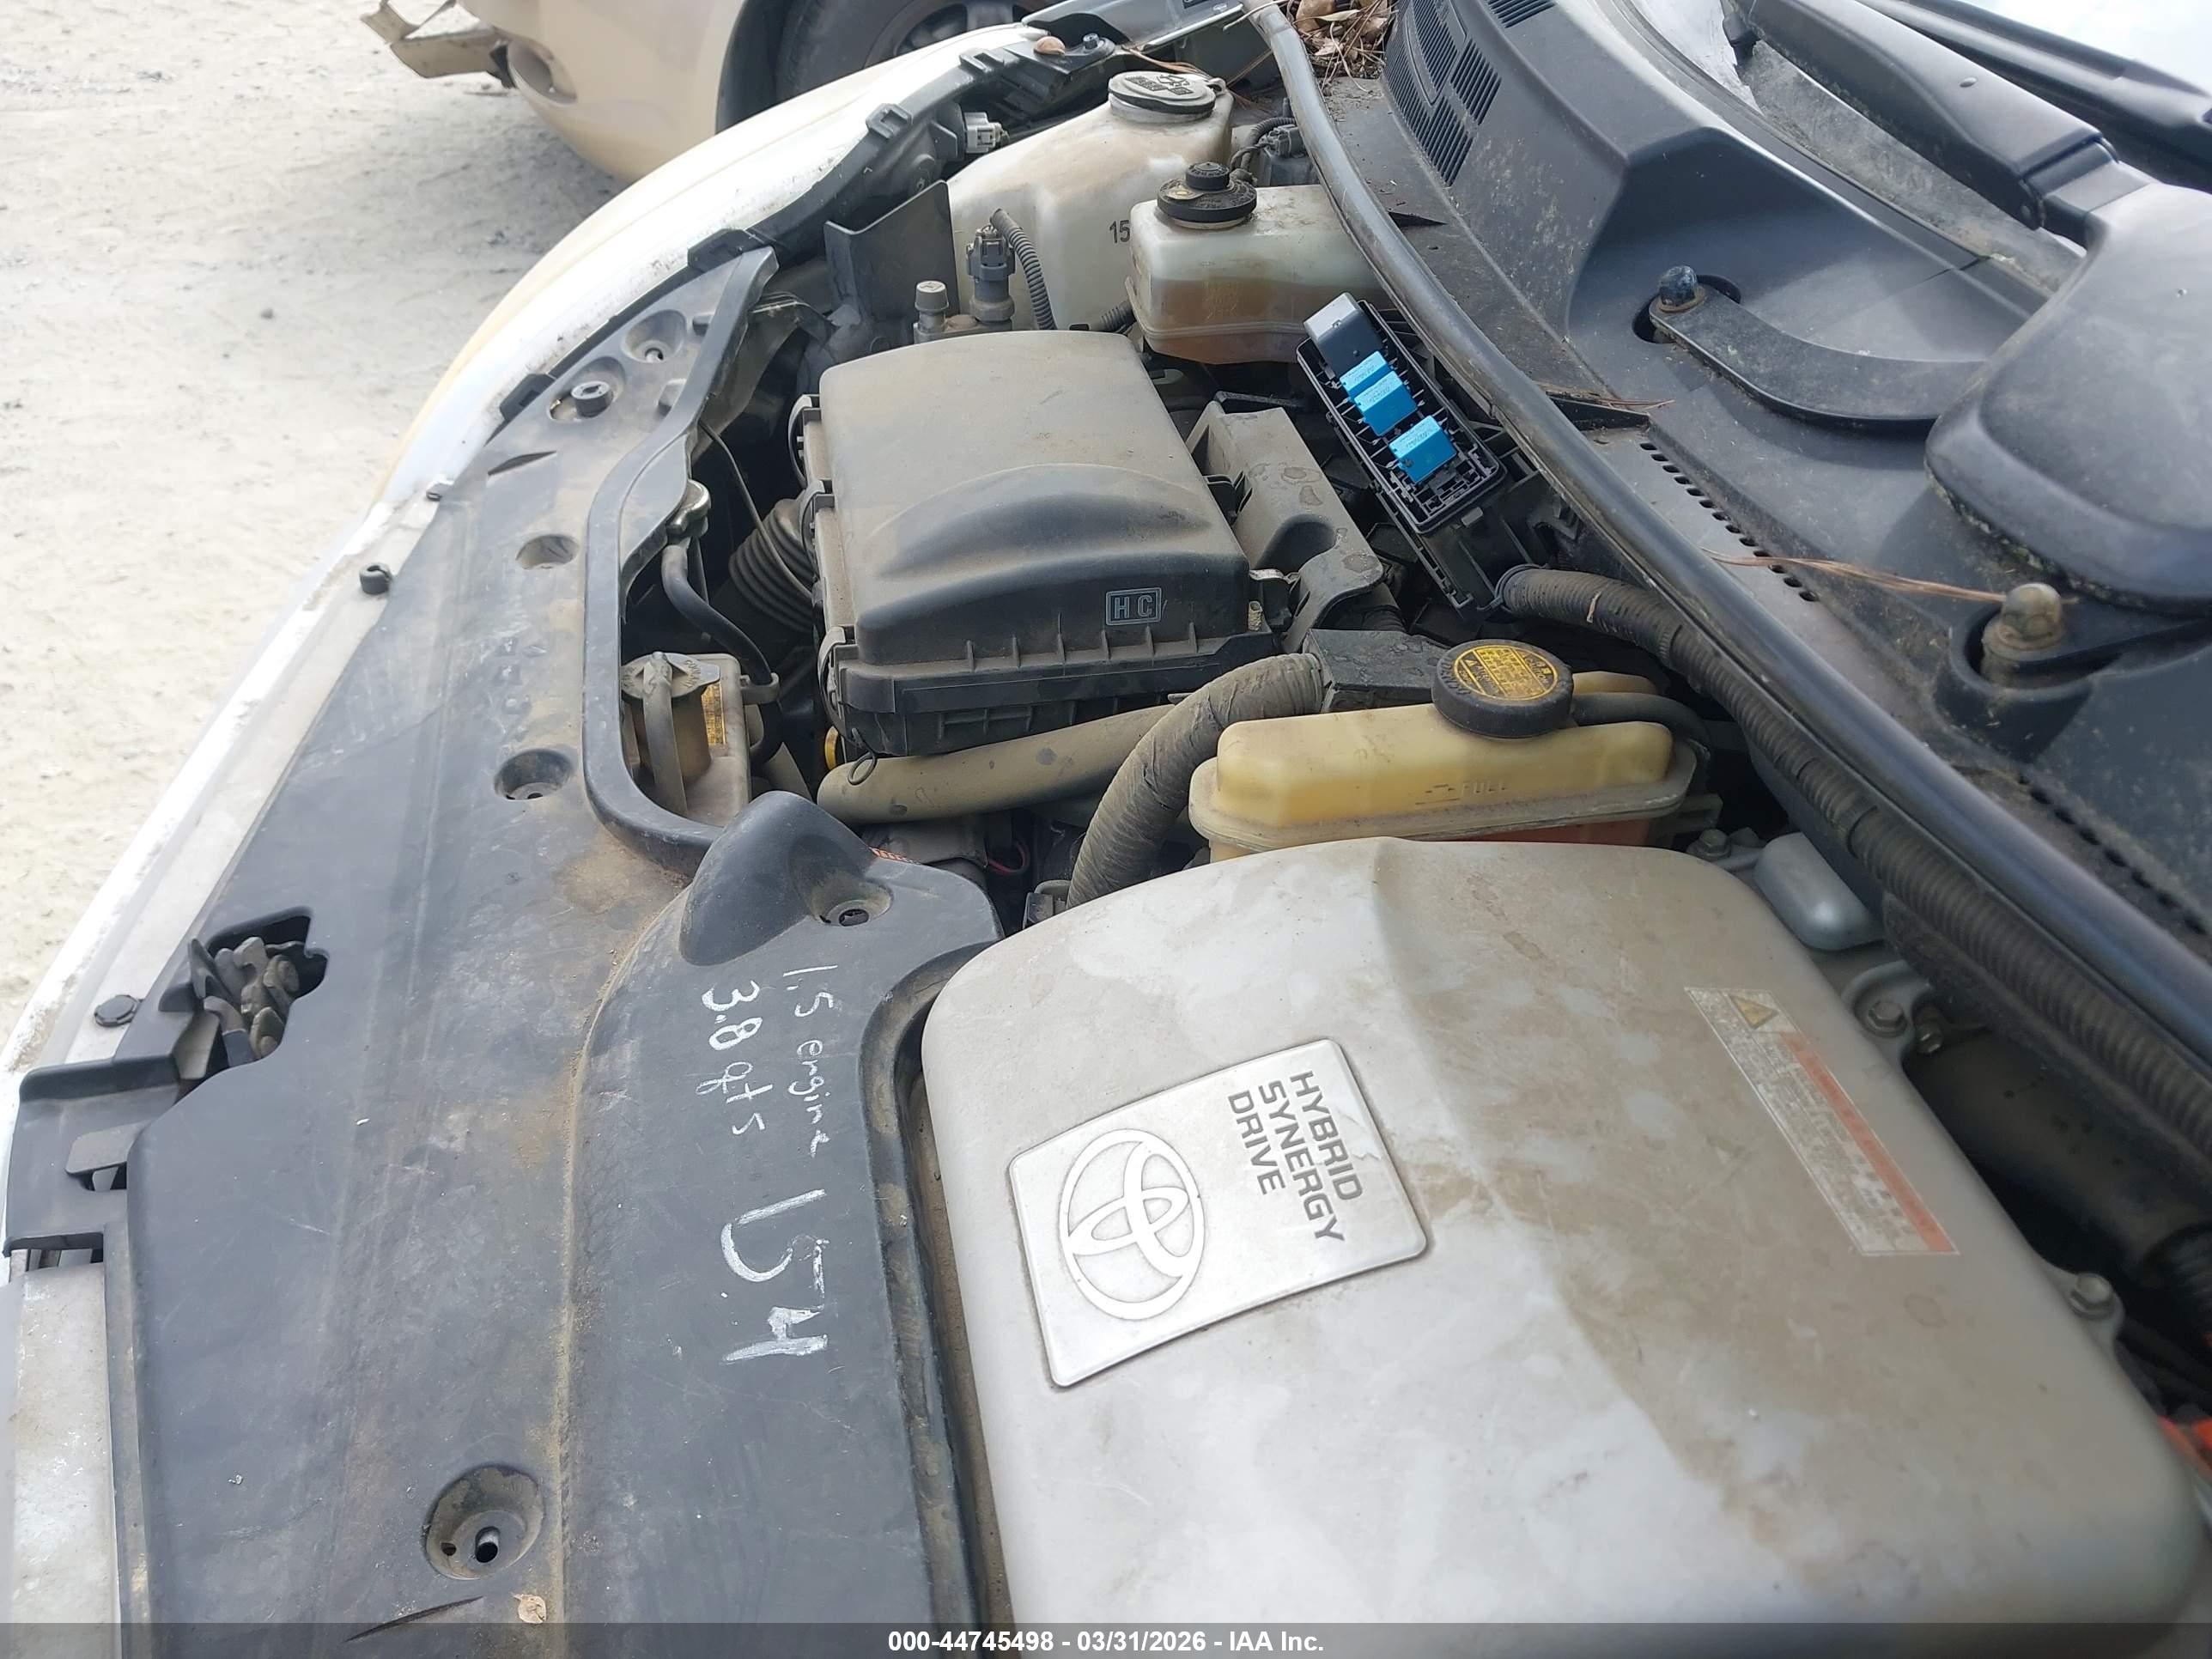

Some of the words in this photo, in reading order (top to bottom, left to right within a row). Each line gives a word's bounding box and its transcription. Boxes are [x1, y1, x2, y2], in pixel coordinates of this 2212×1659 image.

[1109, 219, 1131, 244] 15
[701, 980, 763, 1051] 3.8
[1227, 1090, 1286, 1195] DRIVE
[1257, 1079, 1346, 1242] SYNERGY
[1289, 1070, 1364, 1201] HYBRID
